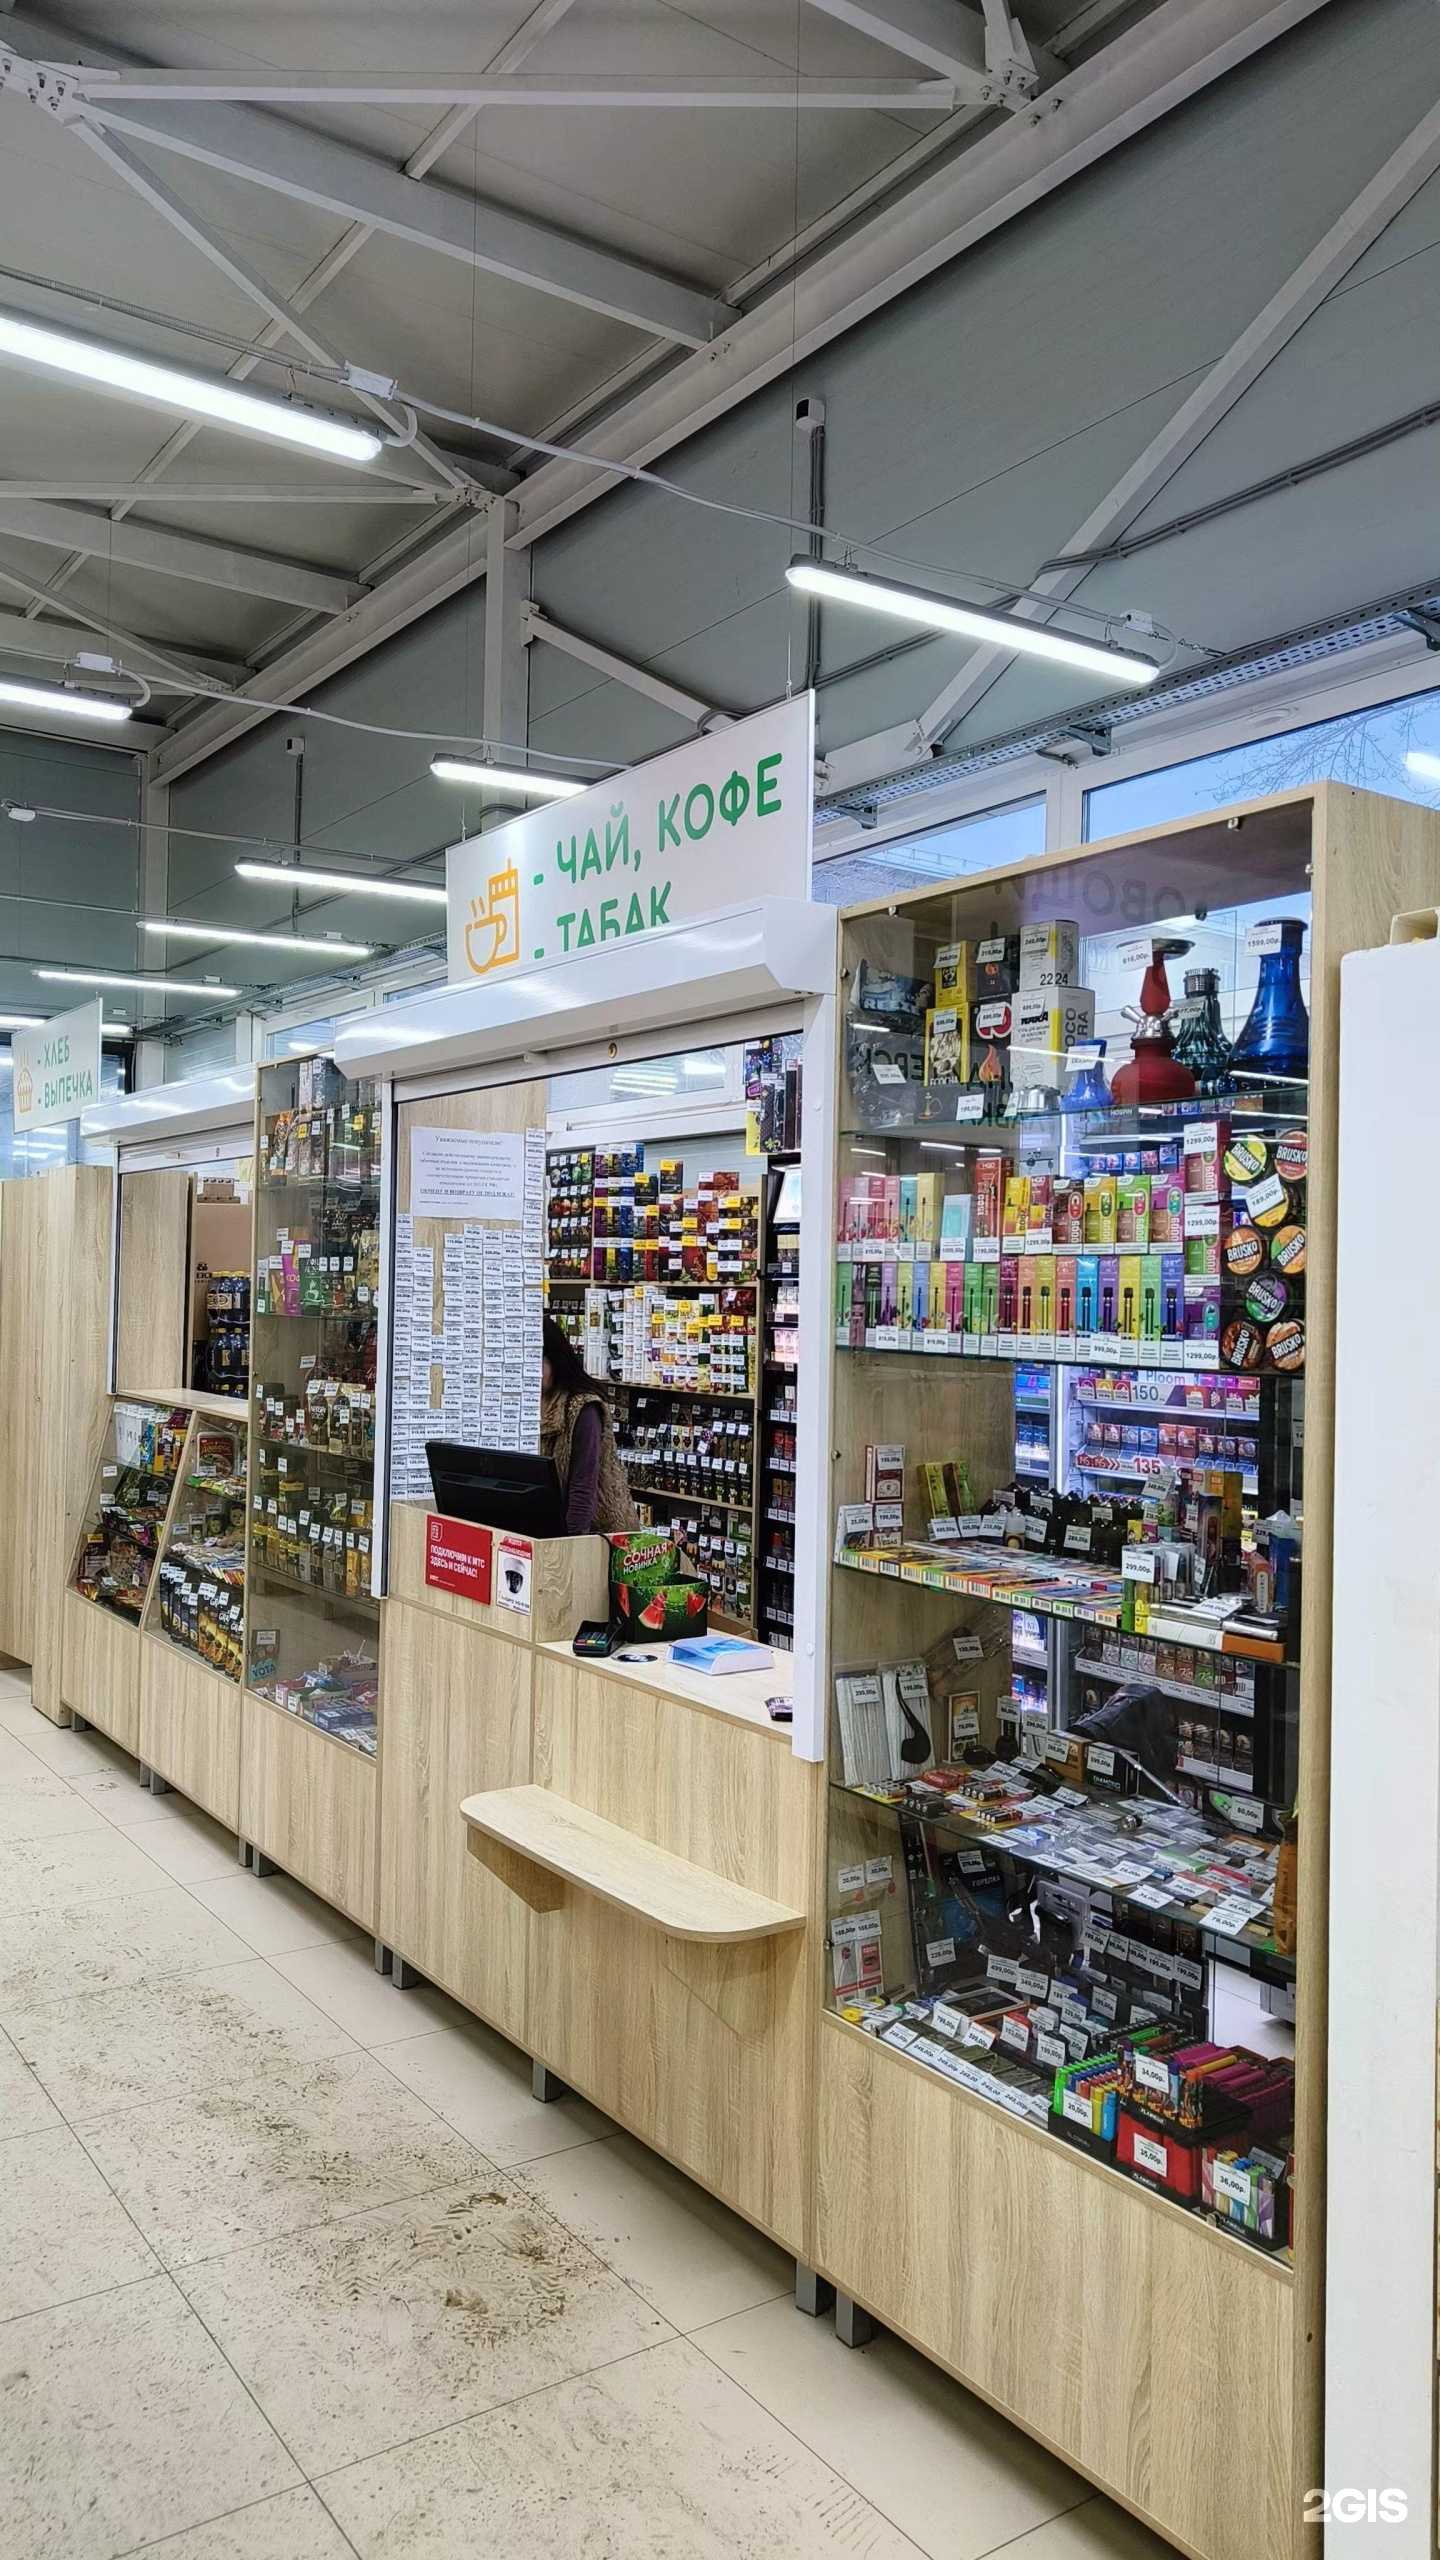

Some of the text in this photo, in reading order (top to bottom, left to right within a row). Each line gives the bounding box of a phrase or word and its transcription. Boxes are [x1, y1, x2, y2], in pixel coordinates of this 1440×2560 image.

[557, 753, 782, 884] ЧАЙ, КОФЕ
[557, 881, 672, 952] ТАБАК
[44, 1035, 70, 1069] ХЛЕБ
[44, 1070, 93, 1108] ВЫПЕЧКА
[1231, 1143, 1260, 1171] BRUSKO
[1276, 1145, 1307, 1162] BRUSKO
[1227, 1241, 1258, 1262] BRUSKO
[1277, 1234, 1305, 1266] BRUSKO
[1248, 1281, 1278, 1309] BRUSKO
[1231, 1329, 1250, 1366] BRUSKO
[1271, 1333, 1301, 1359] BRUSKO
[1132, 1385, 1159, 1401] 150
[1134, 1457, 1161, 1475] 135
[623, 1542, 667, 1566] СОЧНАЯ
[623, 1557, 658, 1575] НОВИНКА
